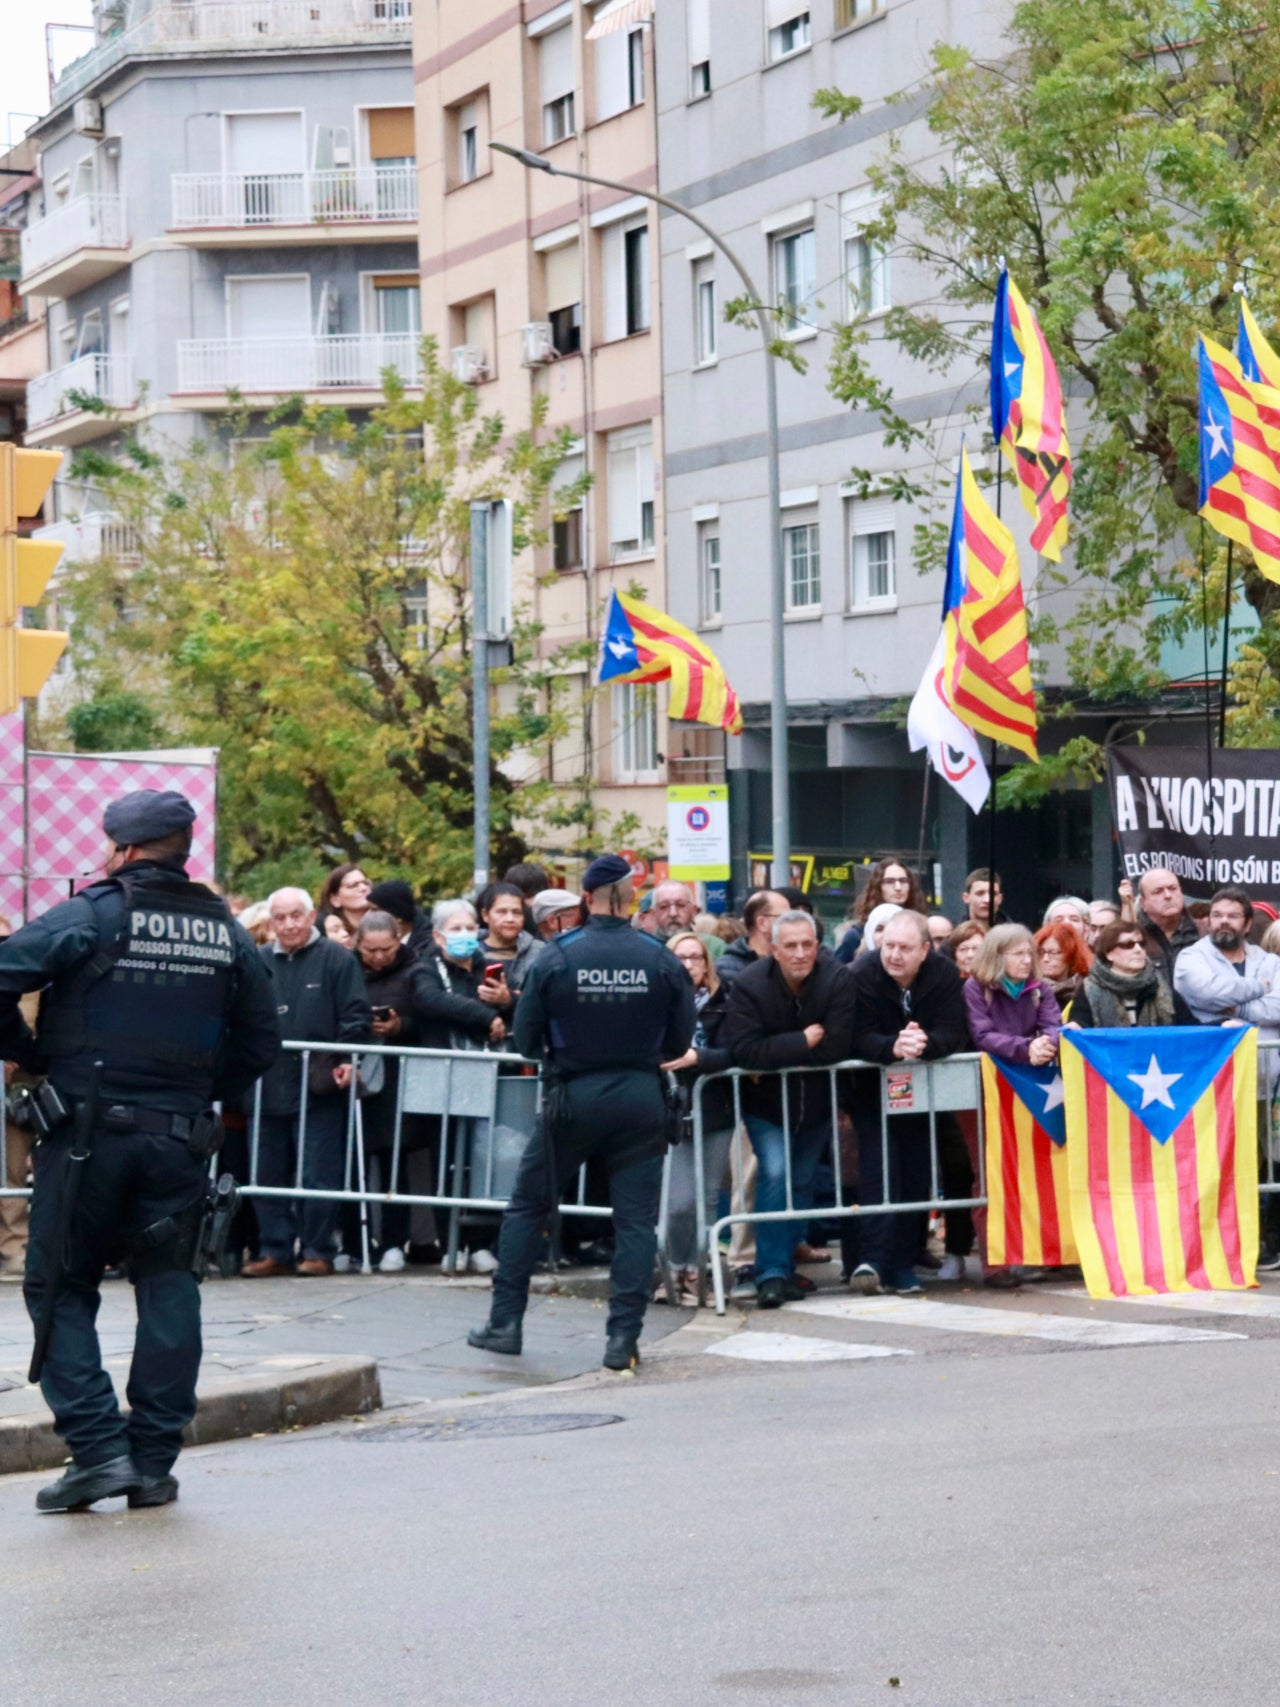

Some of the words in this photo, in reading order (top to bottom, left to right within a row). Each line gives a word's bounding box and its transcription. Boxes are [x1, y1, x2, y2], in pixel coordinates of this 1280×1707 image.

[1116, 775, 1138, 831] A
[1124, 852, 1149, 877] ELS
[1232, 855, 1268, 884] SÓN
[131, 911, 231, 947] POLICIA
[129, 940, 172, 956] MOSSOS
[173, 943, 232, 964] D'ESQUADRA
[577, 969, 648, 985] POLICIA
